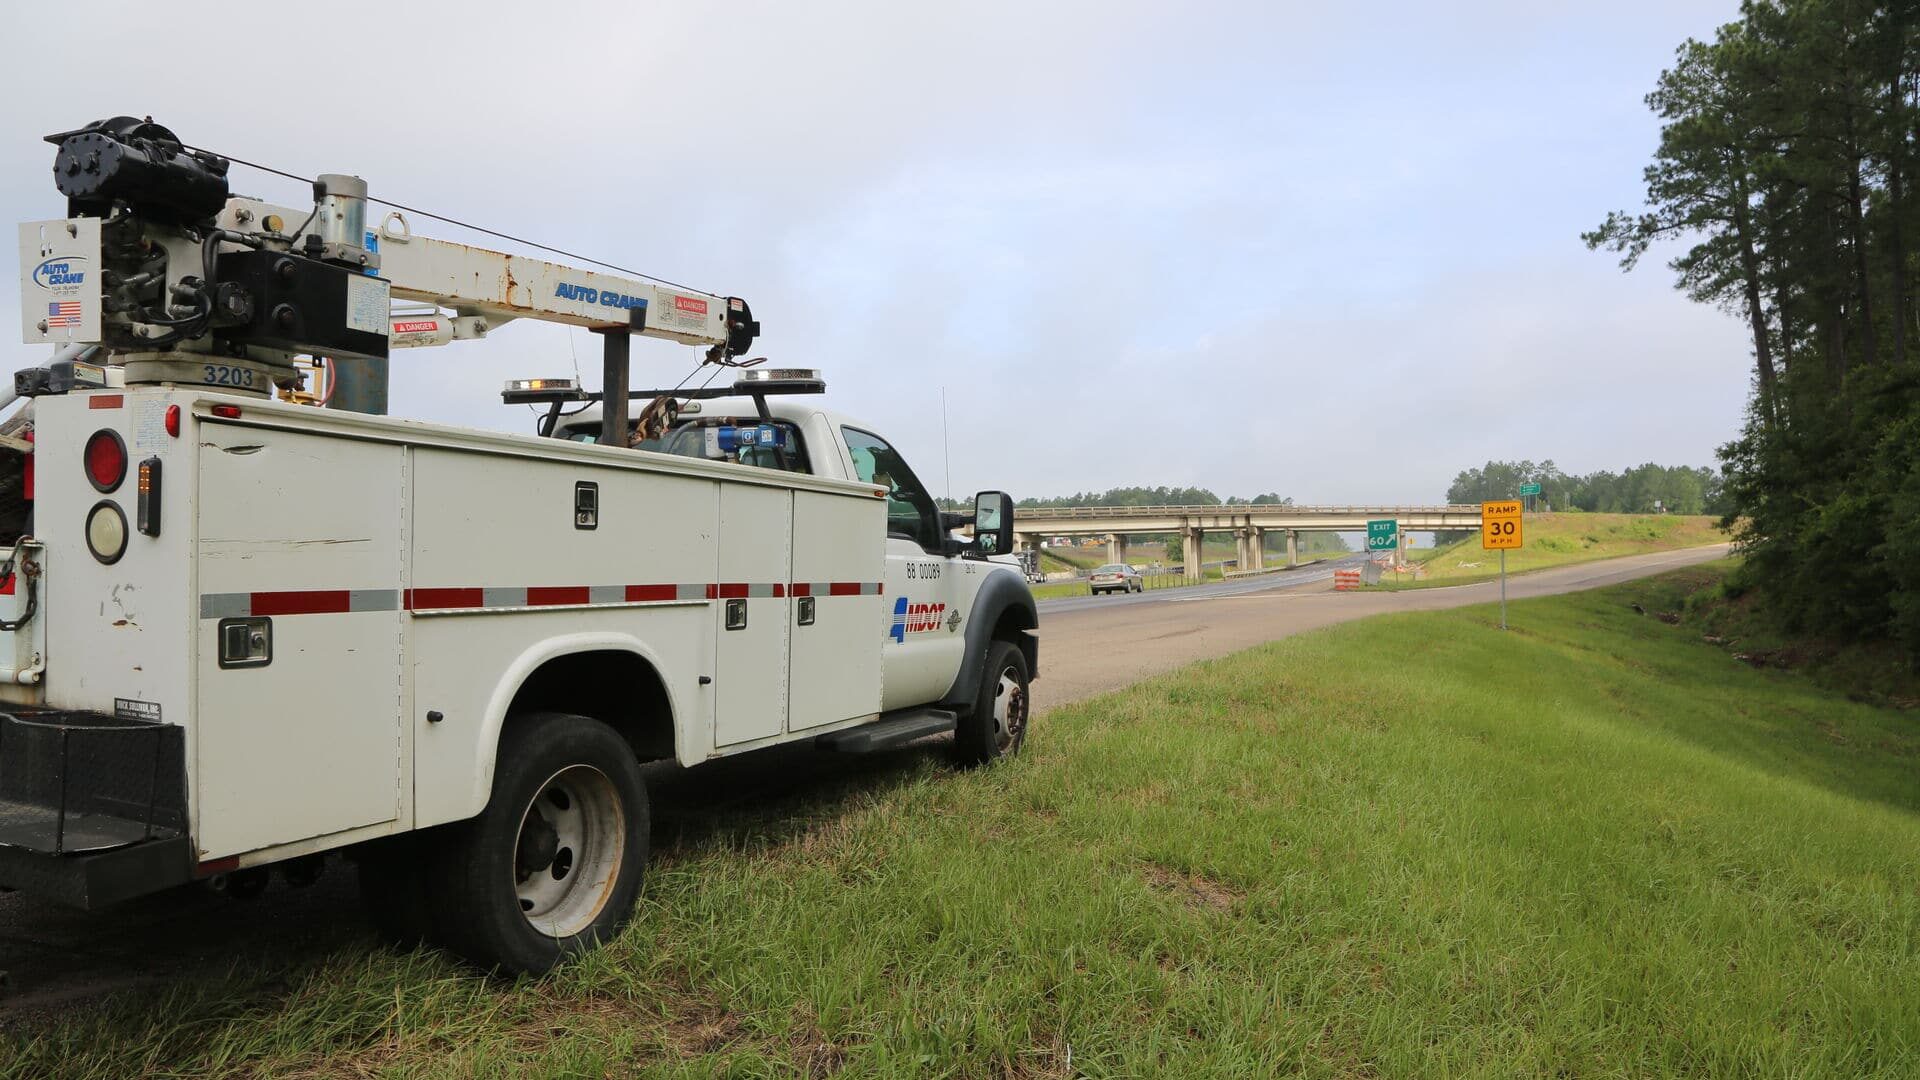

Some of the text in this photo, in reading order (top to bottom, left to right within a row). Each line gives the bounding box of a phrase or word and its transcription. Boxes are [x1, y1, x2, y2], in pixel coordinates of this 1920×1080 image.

[41, 263, 69, 275] AUTO
[48, 272, 84, 285] CRANE
[555, 282, 597, 304] AUTO
[600, 290, 648, 309] CRANE
[683, 299, 706, 311] DANGER
[405, 322, 433, 331] DANGER
[204, 365, 253, 387] 3203
[1488, 506, 1517, 514] RAMP
[1373, 523, 1390, 531] EXIT
[1491, 521, 1515, 536] 30
[1369, 536, 1384, 546] 60
[907, 562, 940, 579] 88 00089
[905, 603, 945, 633] MDOT
